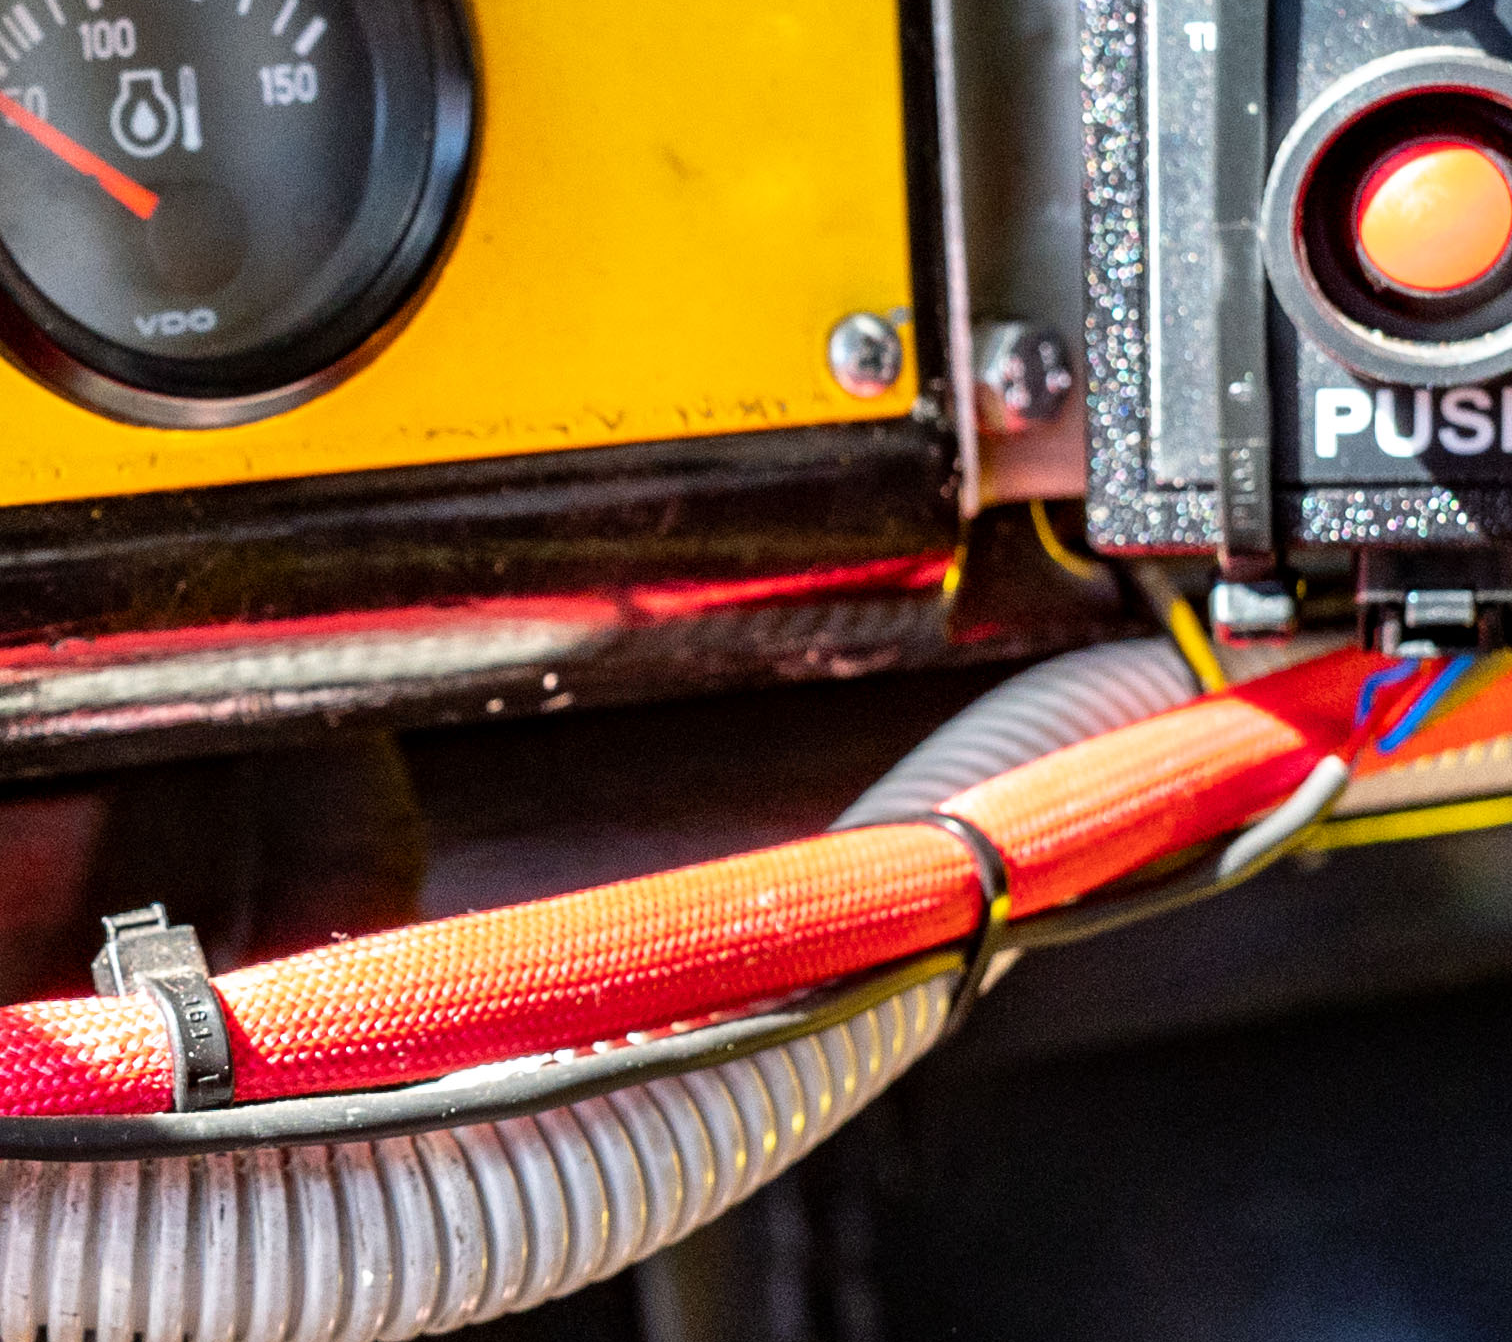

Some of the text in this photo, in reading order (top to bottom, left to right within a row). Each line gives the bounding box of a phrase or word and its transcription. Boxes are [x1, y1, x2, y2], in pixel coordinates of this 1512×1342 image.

[79, 19, 136, 61] 100
[260, 64, 317, 105] 150
[135, 308, 217, 336] VDO
